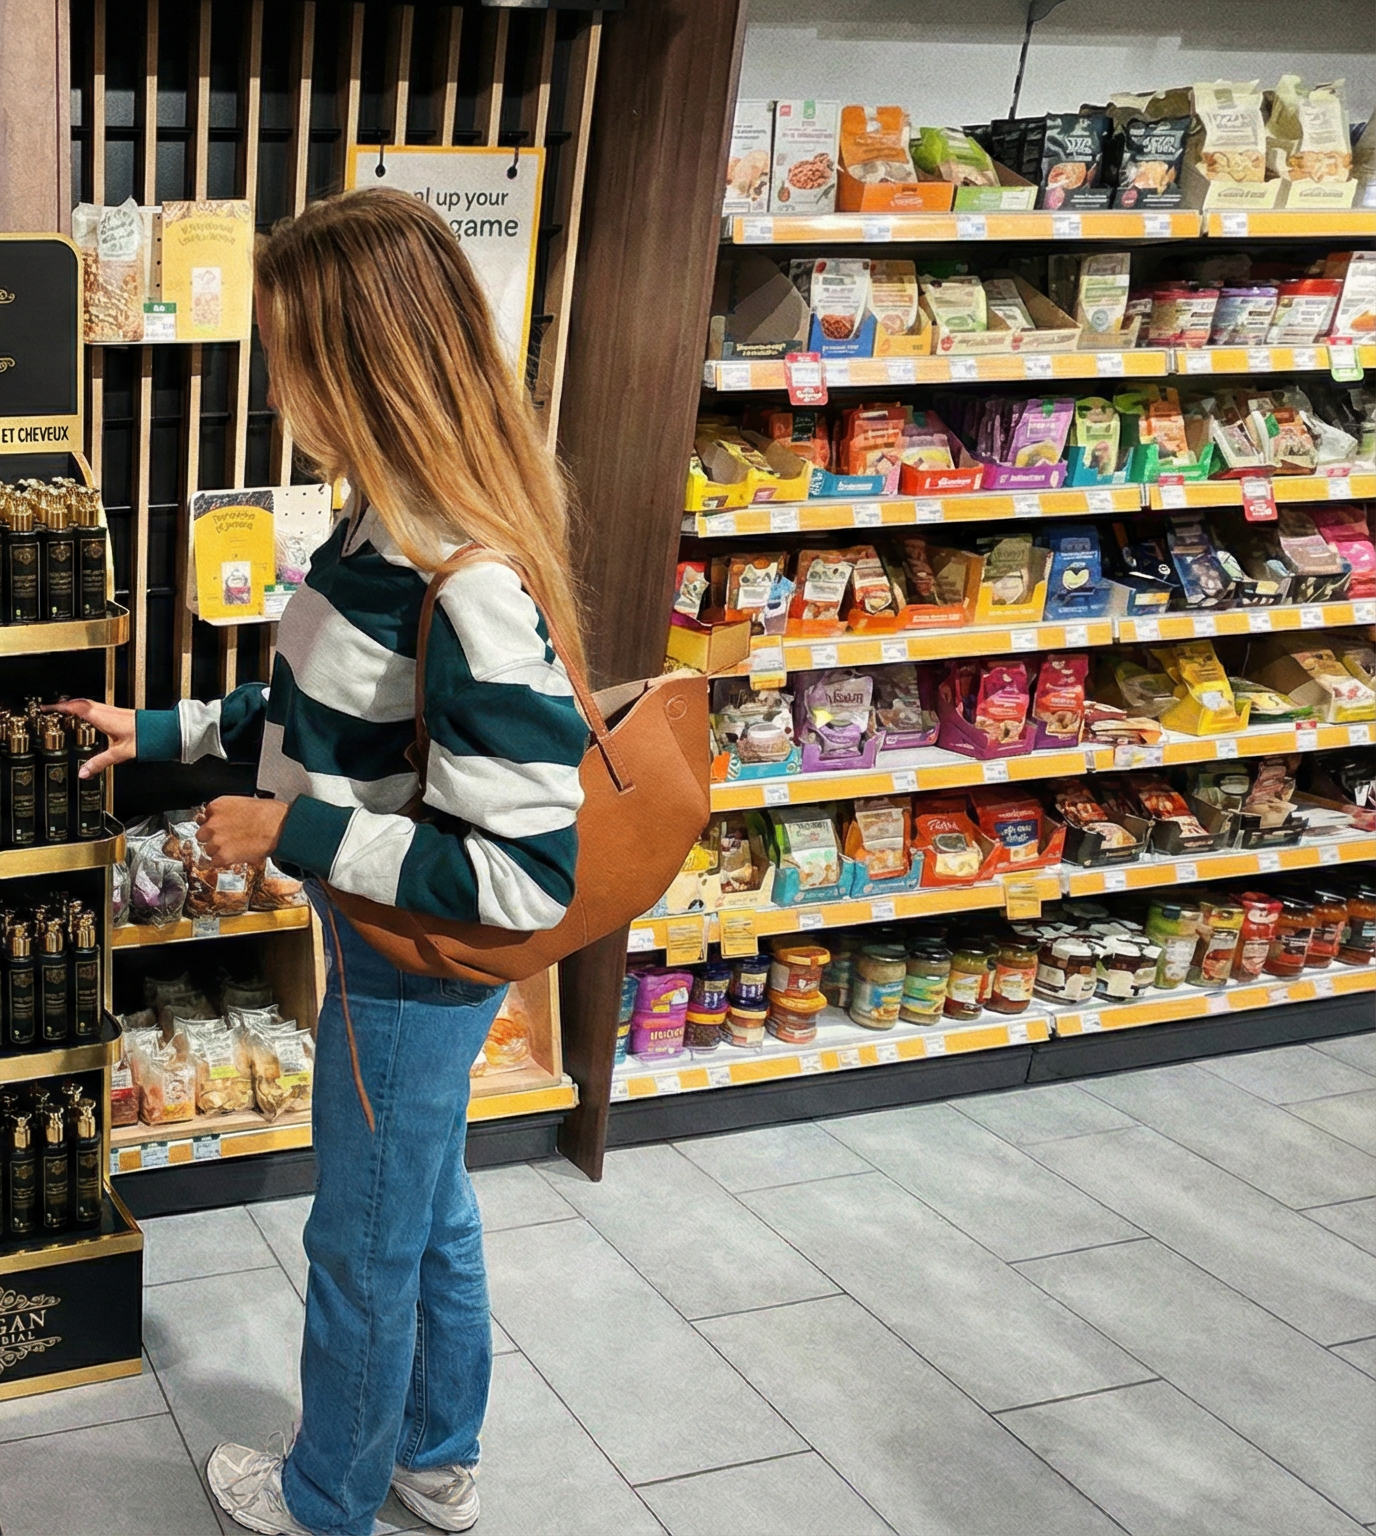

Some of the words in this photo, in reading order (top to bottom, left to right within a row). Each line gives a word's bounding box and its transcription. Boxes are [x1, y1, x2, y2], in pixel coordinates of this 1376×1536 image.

[436, 191, 461, 211] up
[464, 191, 509, 211] your
[449, 218, 519, 242] game
[2, 428, 15, 443] ET
[18, 426, 70, 443] CHEVEUX
